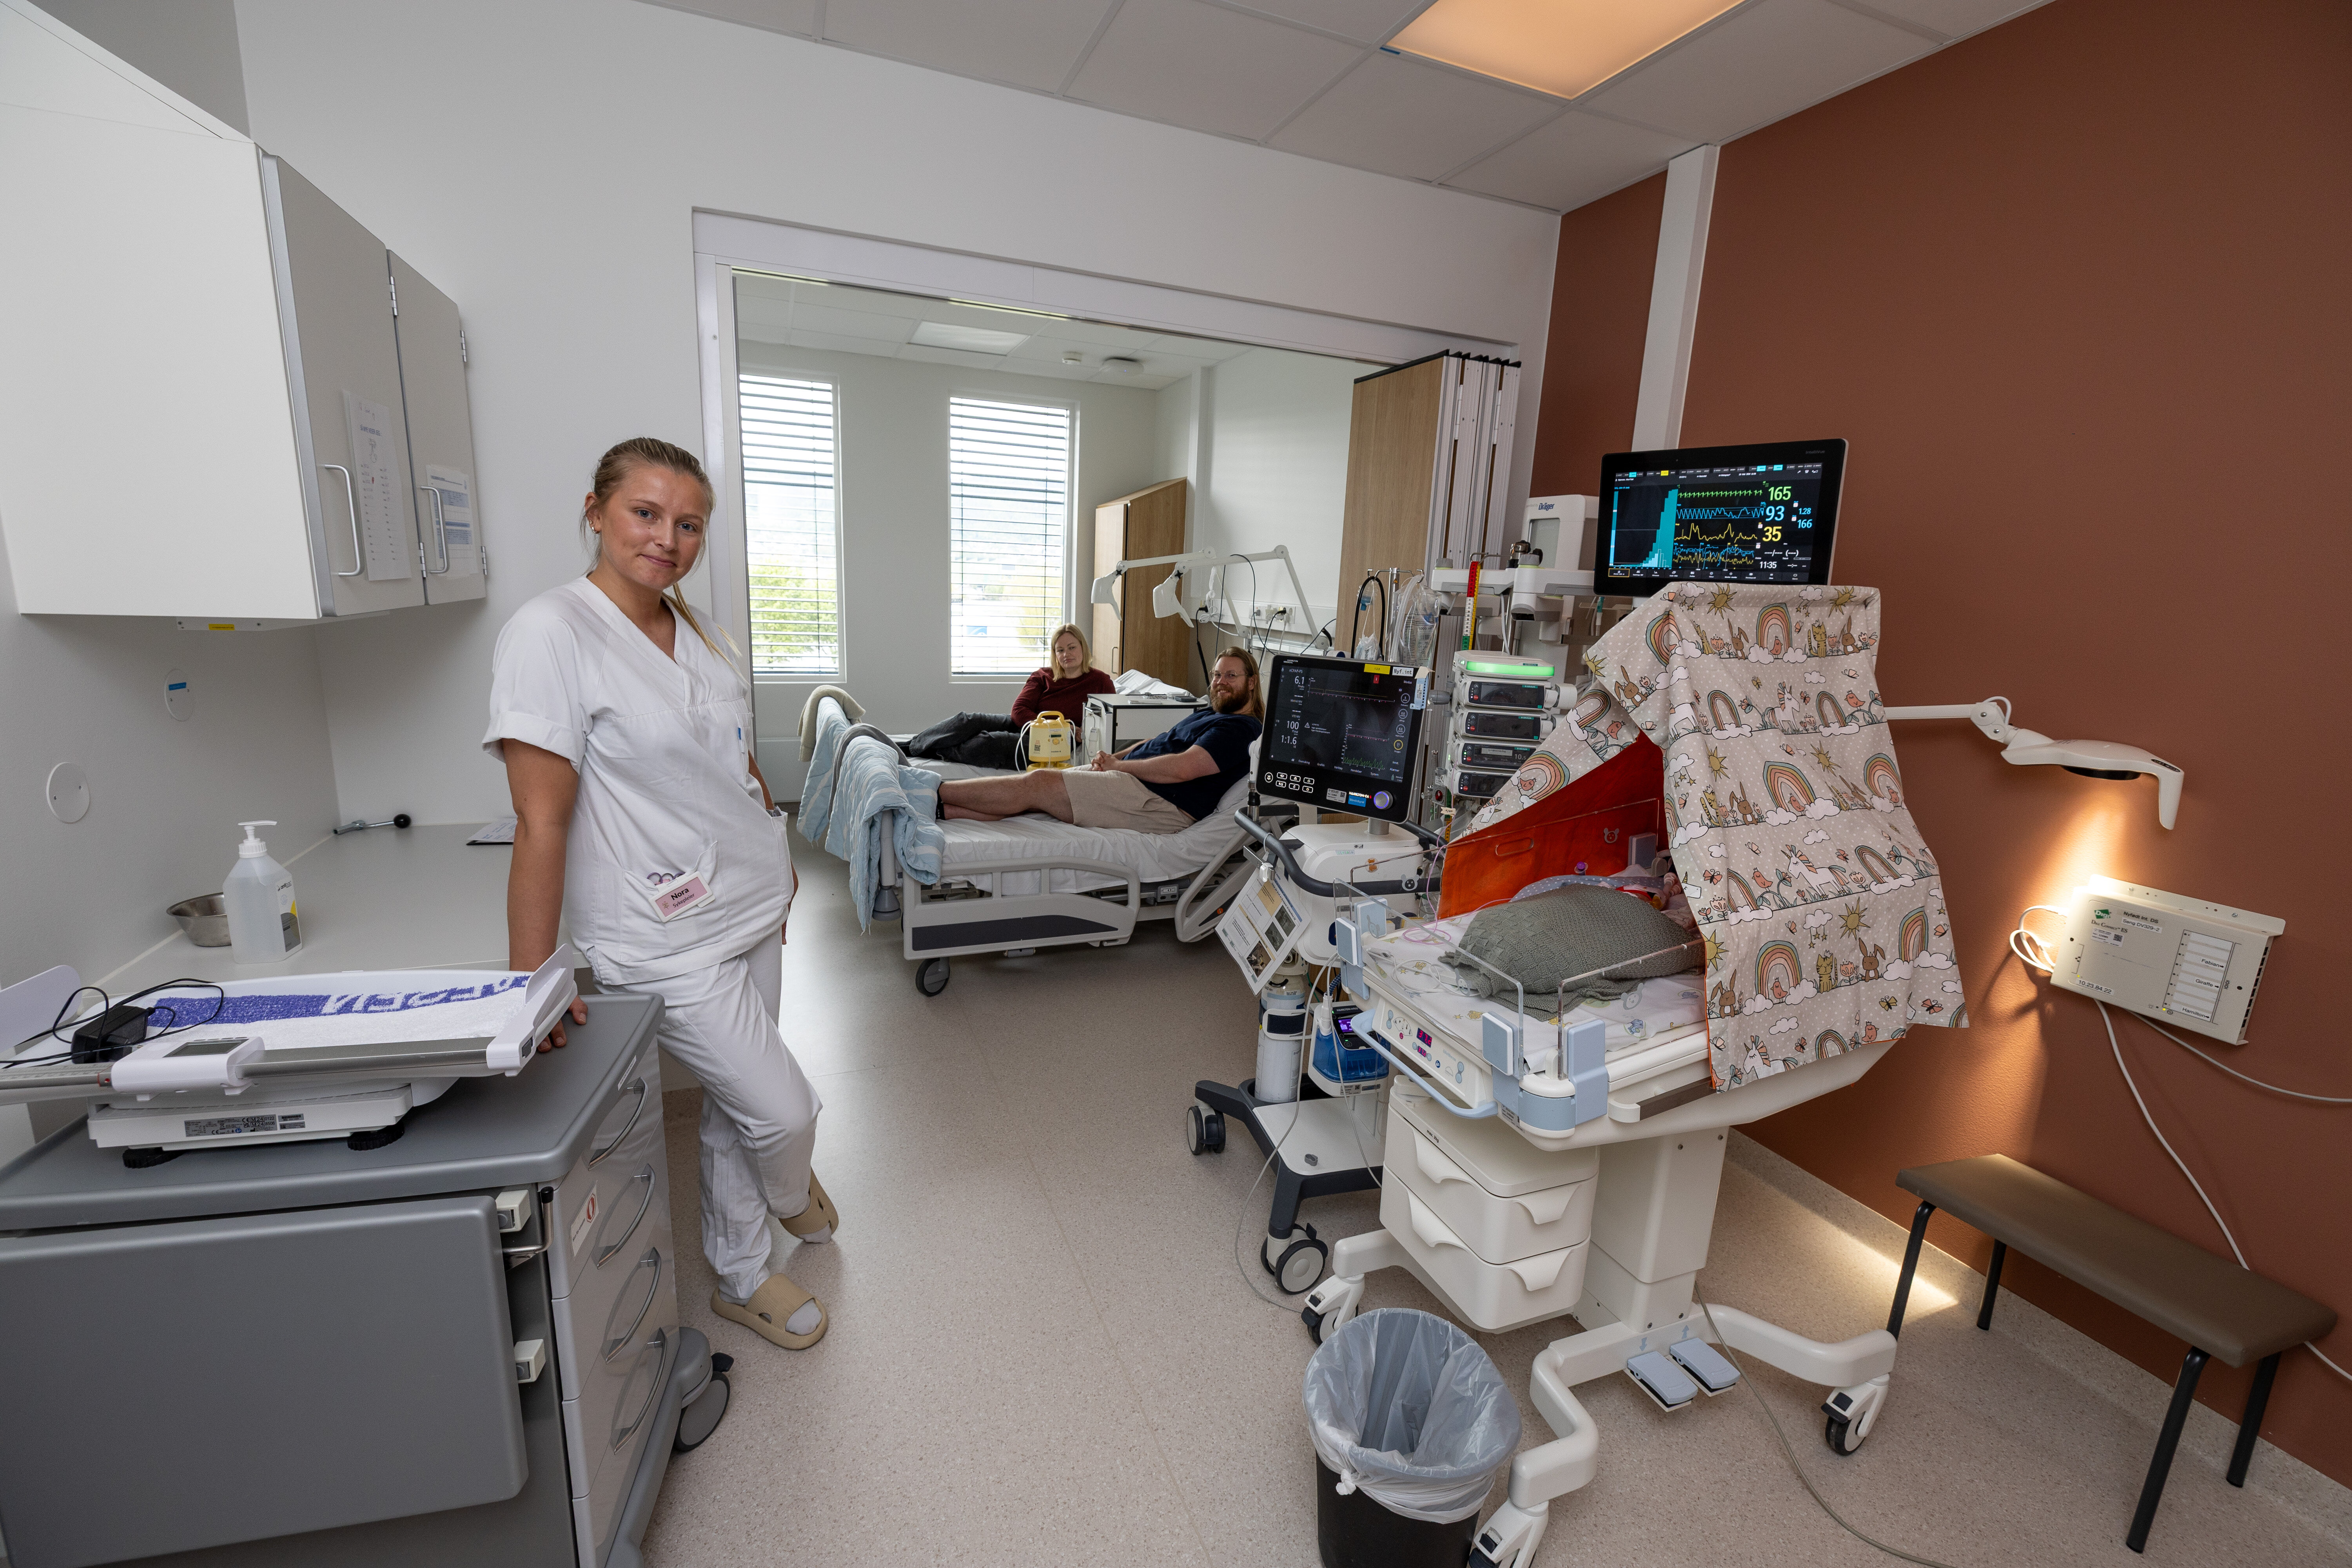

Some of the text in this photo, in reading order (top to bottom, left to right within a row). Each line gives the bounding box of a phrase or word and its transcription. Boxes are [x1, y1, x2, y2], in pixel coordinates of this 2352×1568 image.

[1768, 486, 1791, 501] 165
[1539, 503, 1555, 511] Dräger
[1766, 506, 1784, 521] 93
[1797, 519, 1812, 529] 166
[1762, 526, 1782, 541] 35
[1295, 676, 1305, 684] 6.1
[1287, 720, 1299, 730] 100
[1281, 735, 1297, 745] 1:1.6
[671, 887, 689, 900] Nora
[673, 893, 695, 908] Sykepleier
[2095, 910, 2110, 919] Digi
[2137, 922, 2160, 932] DV329-2
[2201, 959, 2220, 967] Fabian
[2079, 980, 2112, 994] 10.23.84.22
[2196, 979, 2213, 987] Giraffe
[2182, 1007, 2206, 1018] Hamilton
[1418, 1029, 1432, 1045] 37.2
